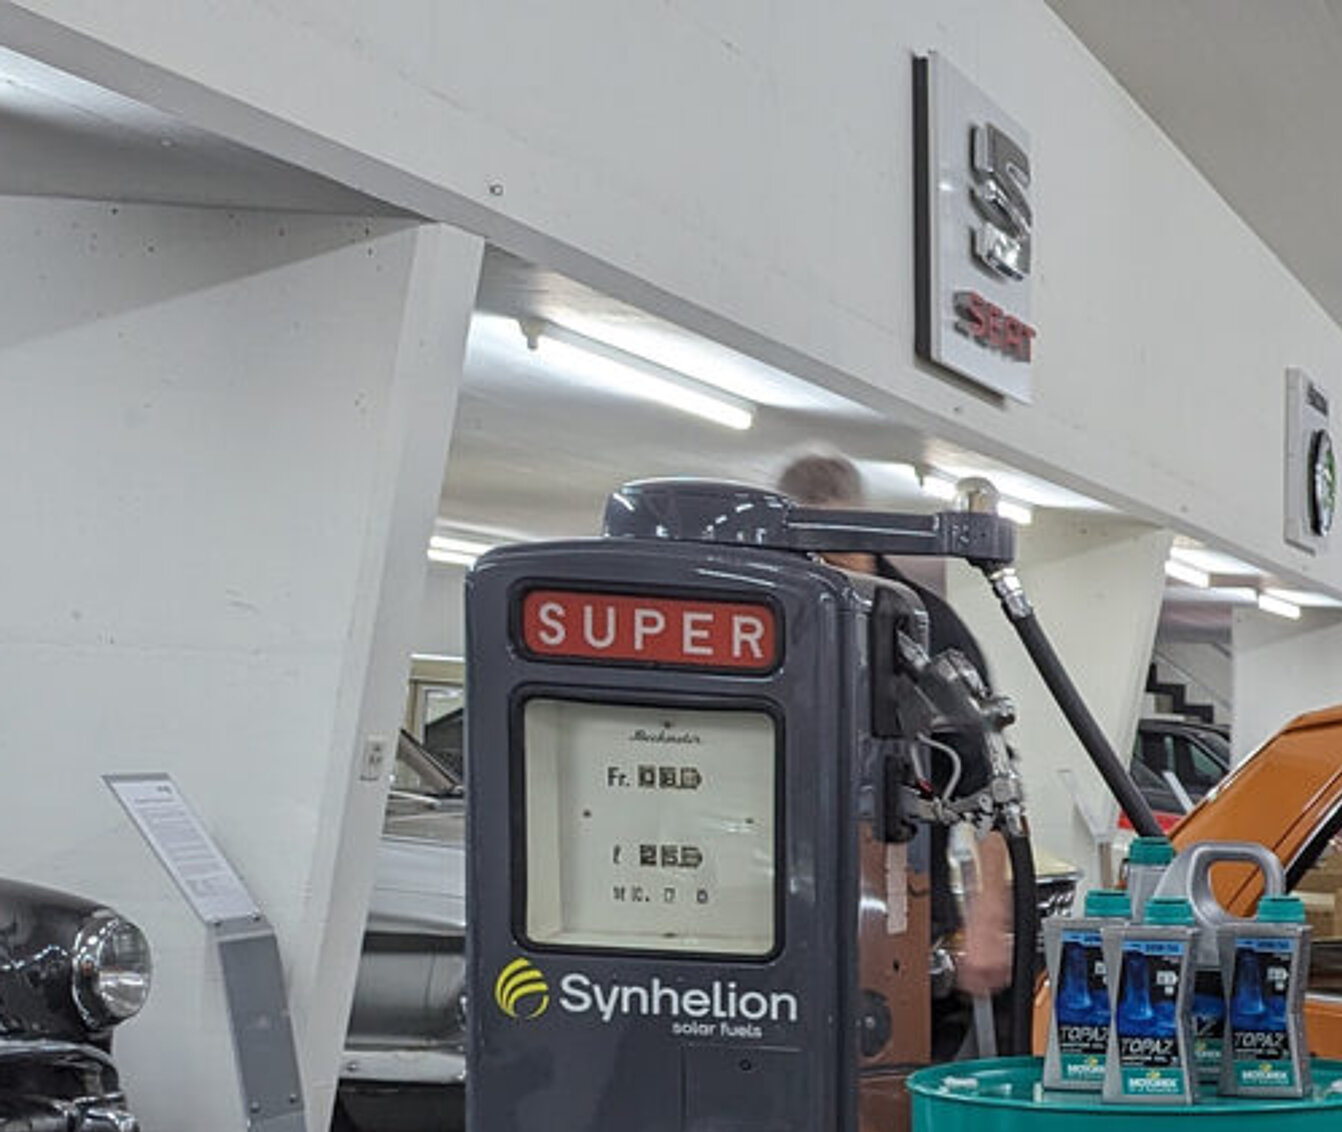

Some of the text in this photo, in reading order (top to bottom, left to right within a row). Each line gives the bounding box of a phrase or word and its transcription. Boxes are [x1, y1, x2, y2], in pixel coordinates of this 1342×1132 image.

[537, 602, 765, 659] SUPER
[558, 972, 799, 1023] Synhelion
[672, 1021, 763, 1038] solar fuels
[1121, 1037, 1175, 1056] TOPAZ
